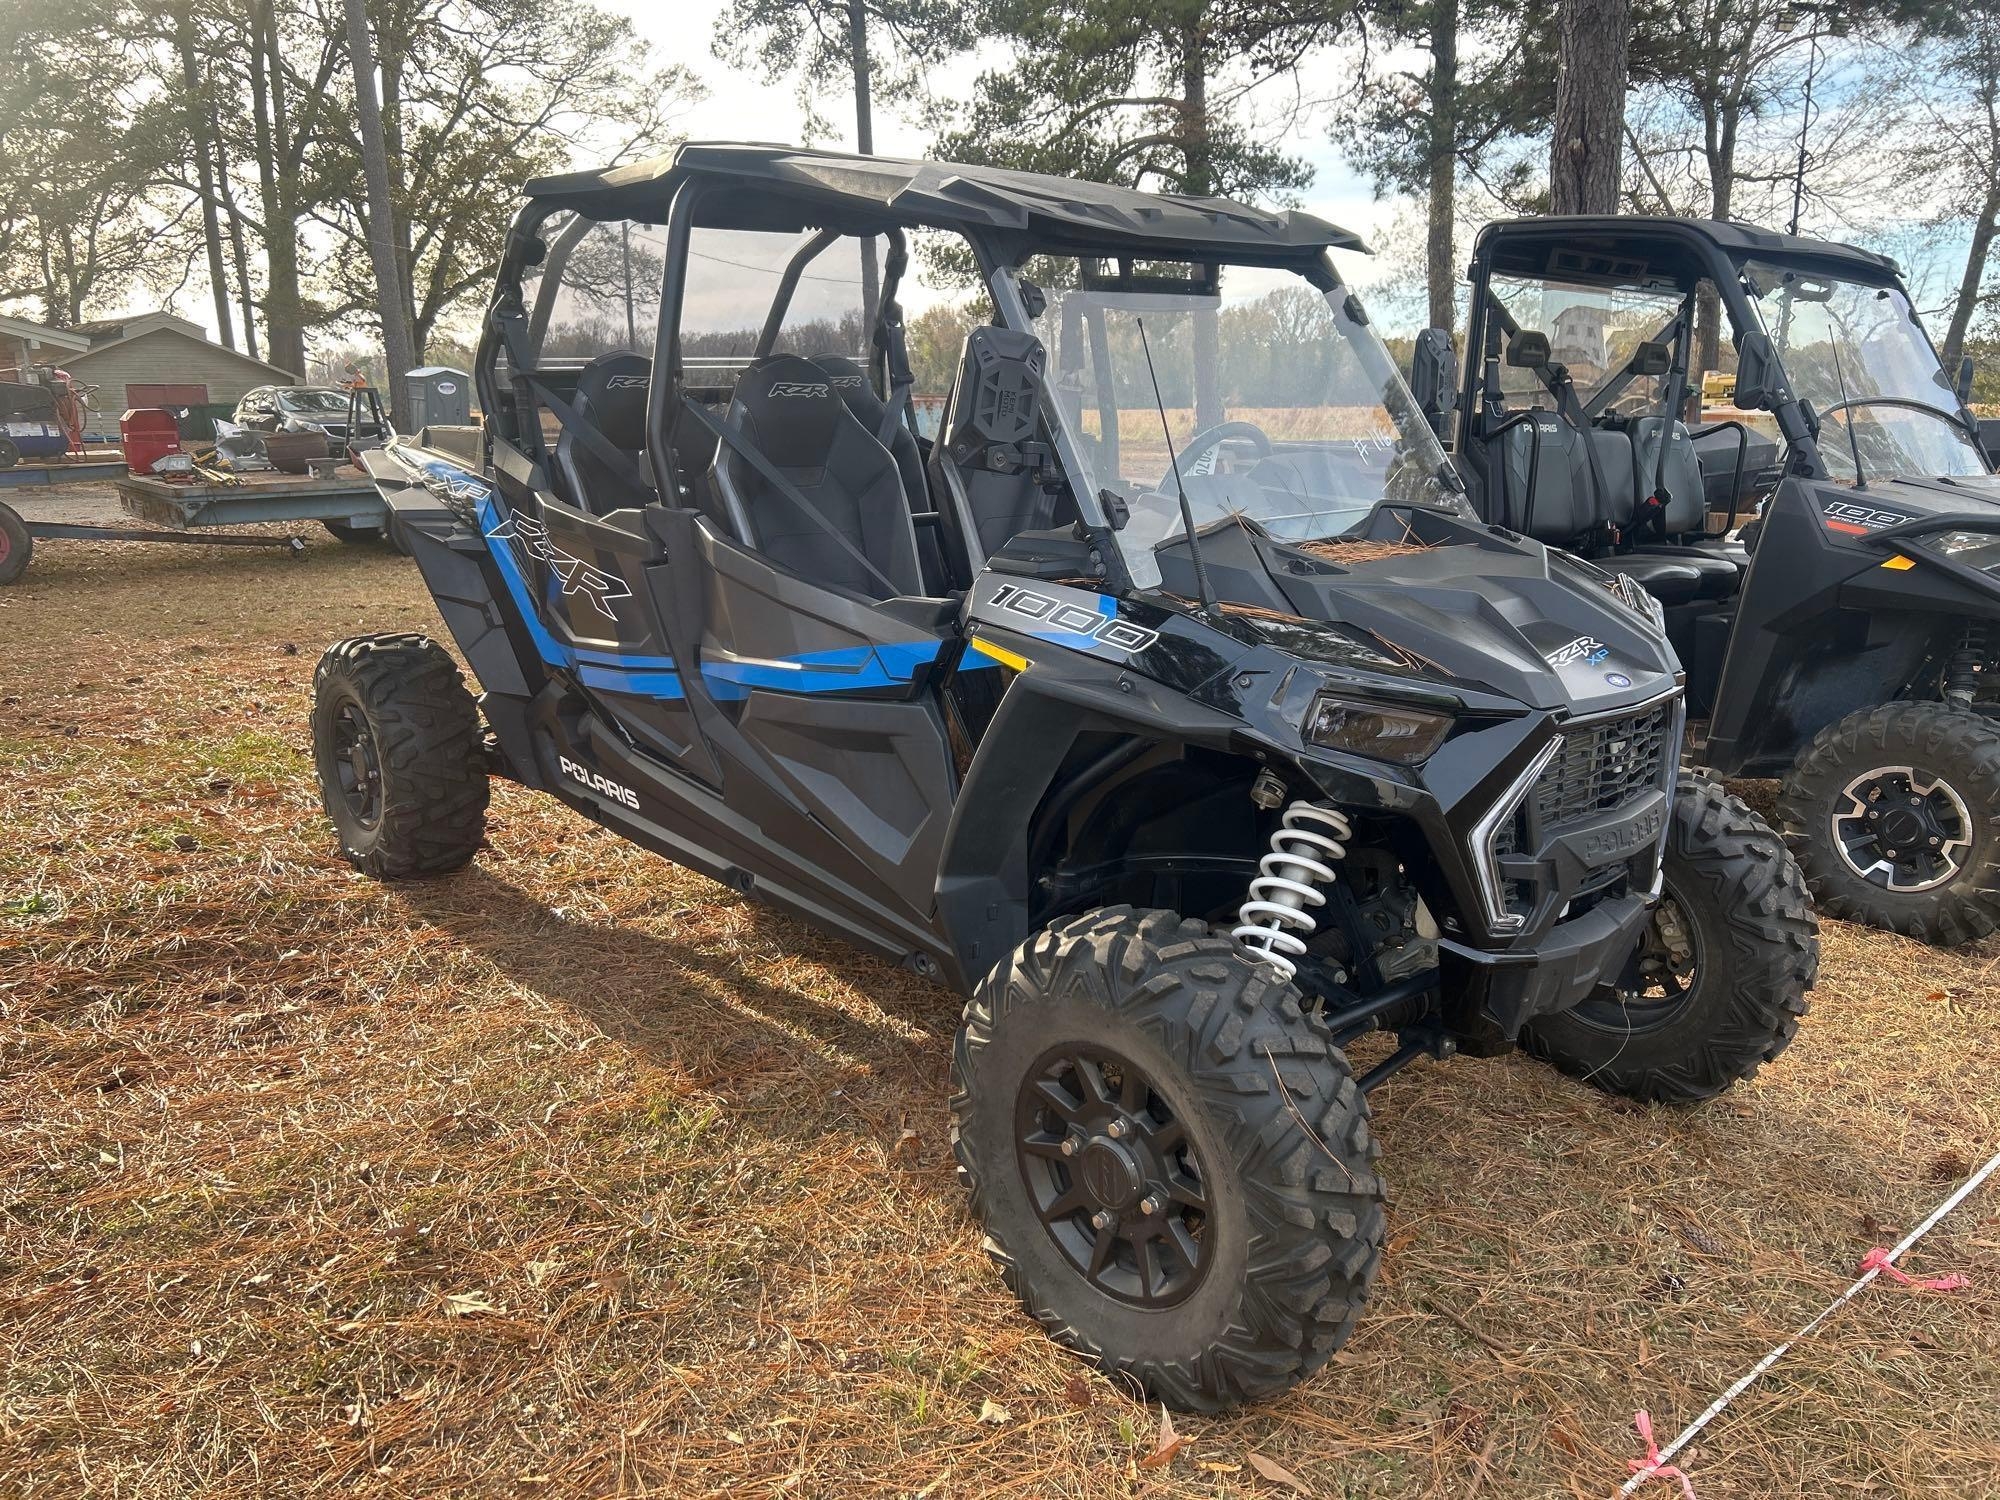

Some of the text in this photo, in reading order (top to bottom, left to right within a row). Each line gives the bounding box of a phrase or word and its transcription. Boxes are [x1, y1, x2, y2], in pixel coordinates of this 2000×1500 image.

[606, 375, 652, 389] RZ
[768, 382, 829, 398] RZR
[829, 376, 862, 388] ZR
[430, 474, 492, 500] XP
[1823, 502, 1916, 527] 100
[485, 508, 633, 622] RZR
[987, 583, 1160, 653] 1000
[1544, 635, 1605, 673] RZR
[1585, 648, 1610, 666] XP
[560, 755, 640, 810] POLARIS
[1584, 808, 1661, 859] POLARIS
